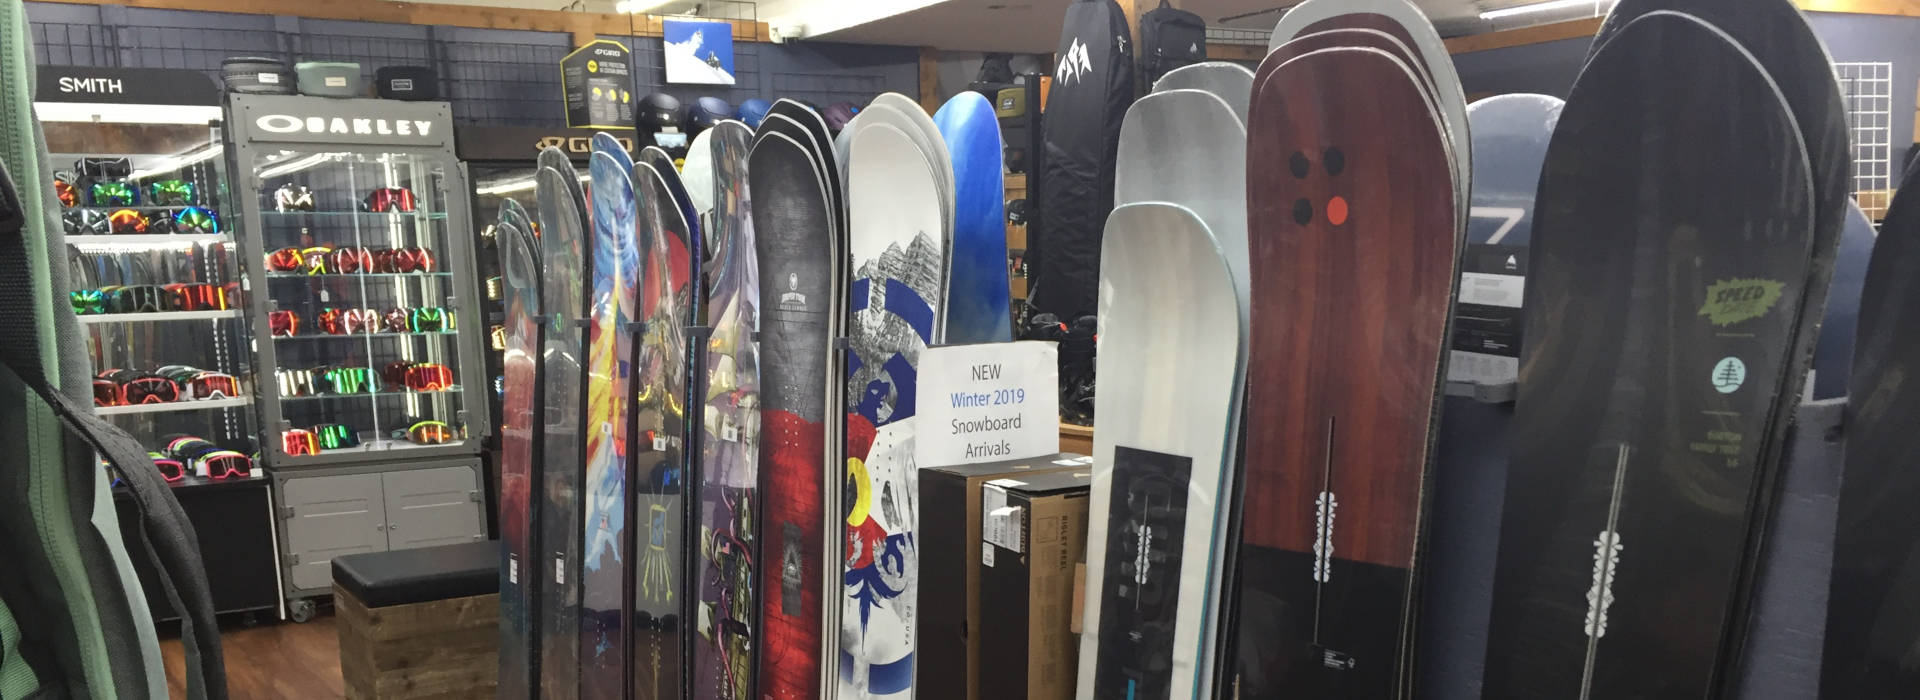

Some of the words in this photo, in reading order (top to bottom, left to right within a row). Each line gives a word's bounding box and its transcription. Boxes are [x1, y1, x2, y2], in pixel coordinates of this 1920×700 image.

[58, 76, 123, 94] SMITH
[306, 116, 432, 136] OAKLEY
[1715, 285, 1765, 304] SPEED
[972, 363, 1002, 381] NEW
[950, 391, 991, 409] Winter
[993, 387, 1025, 406] 2019
[951, 413, 1022, 435] Snowboard
[965, 439, 1011, 459] Arrivals
